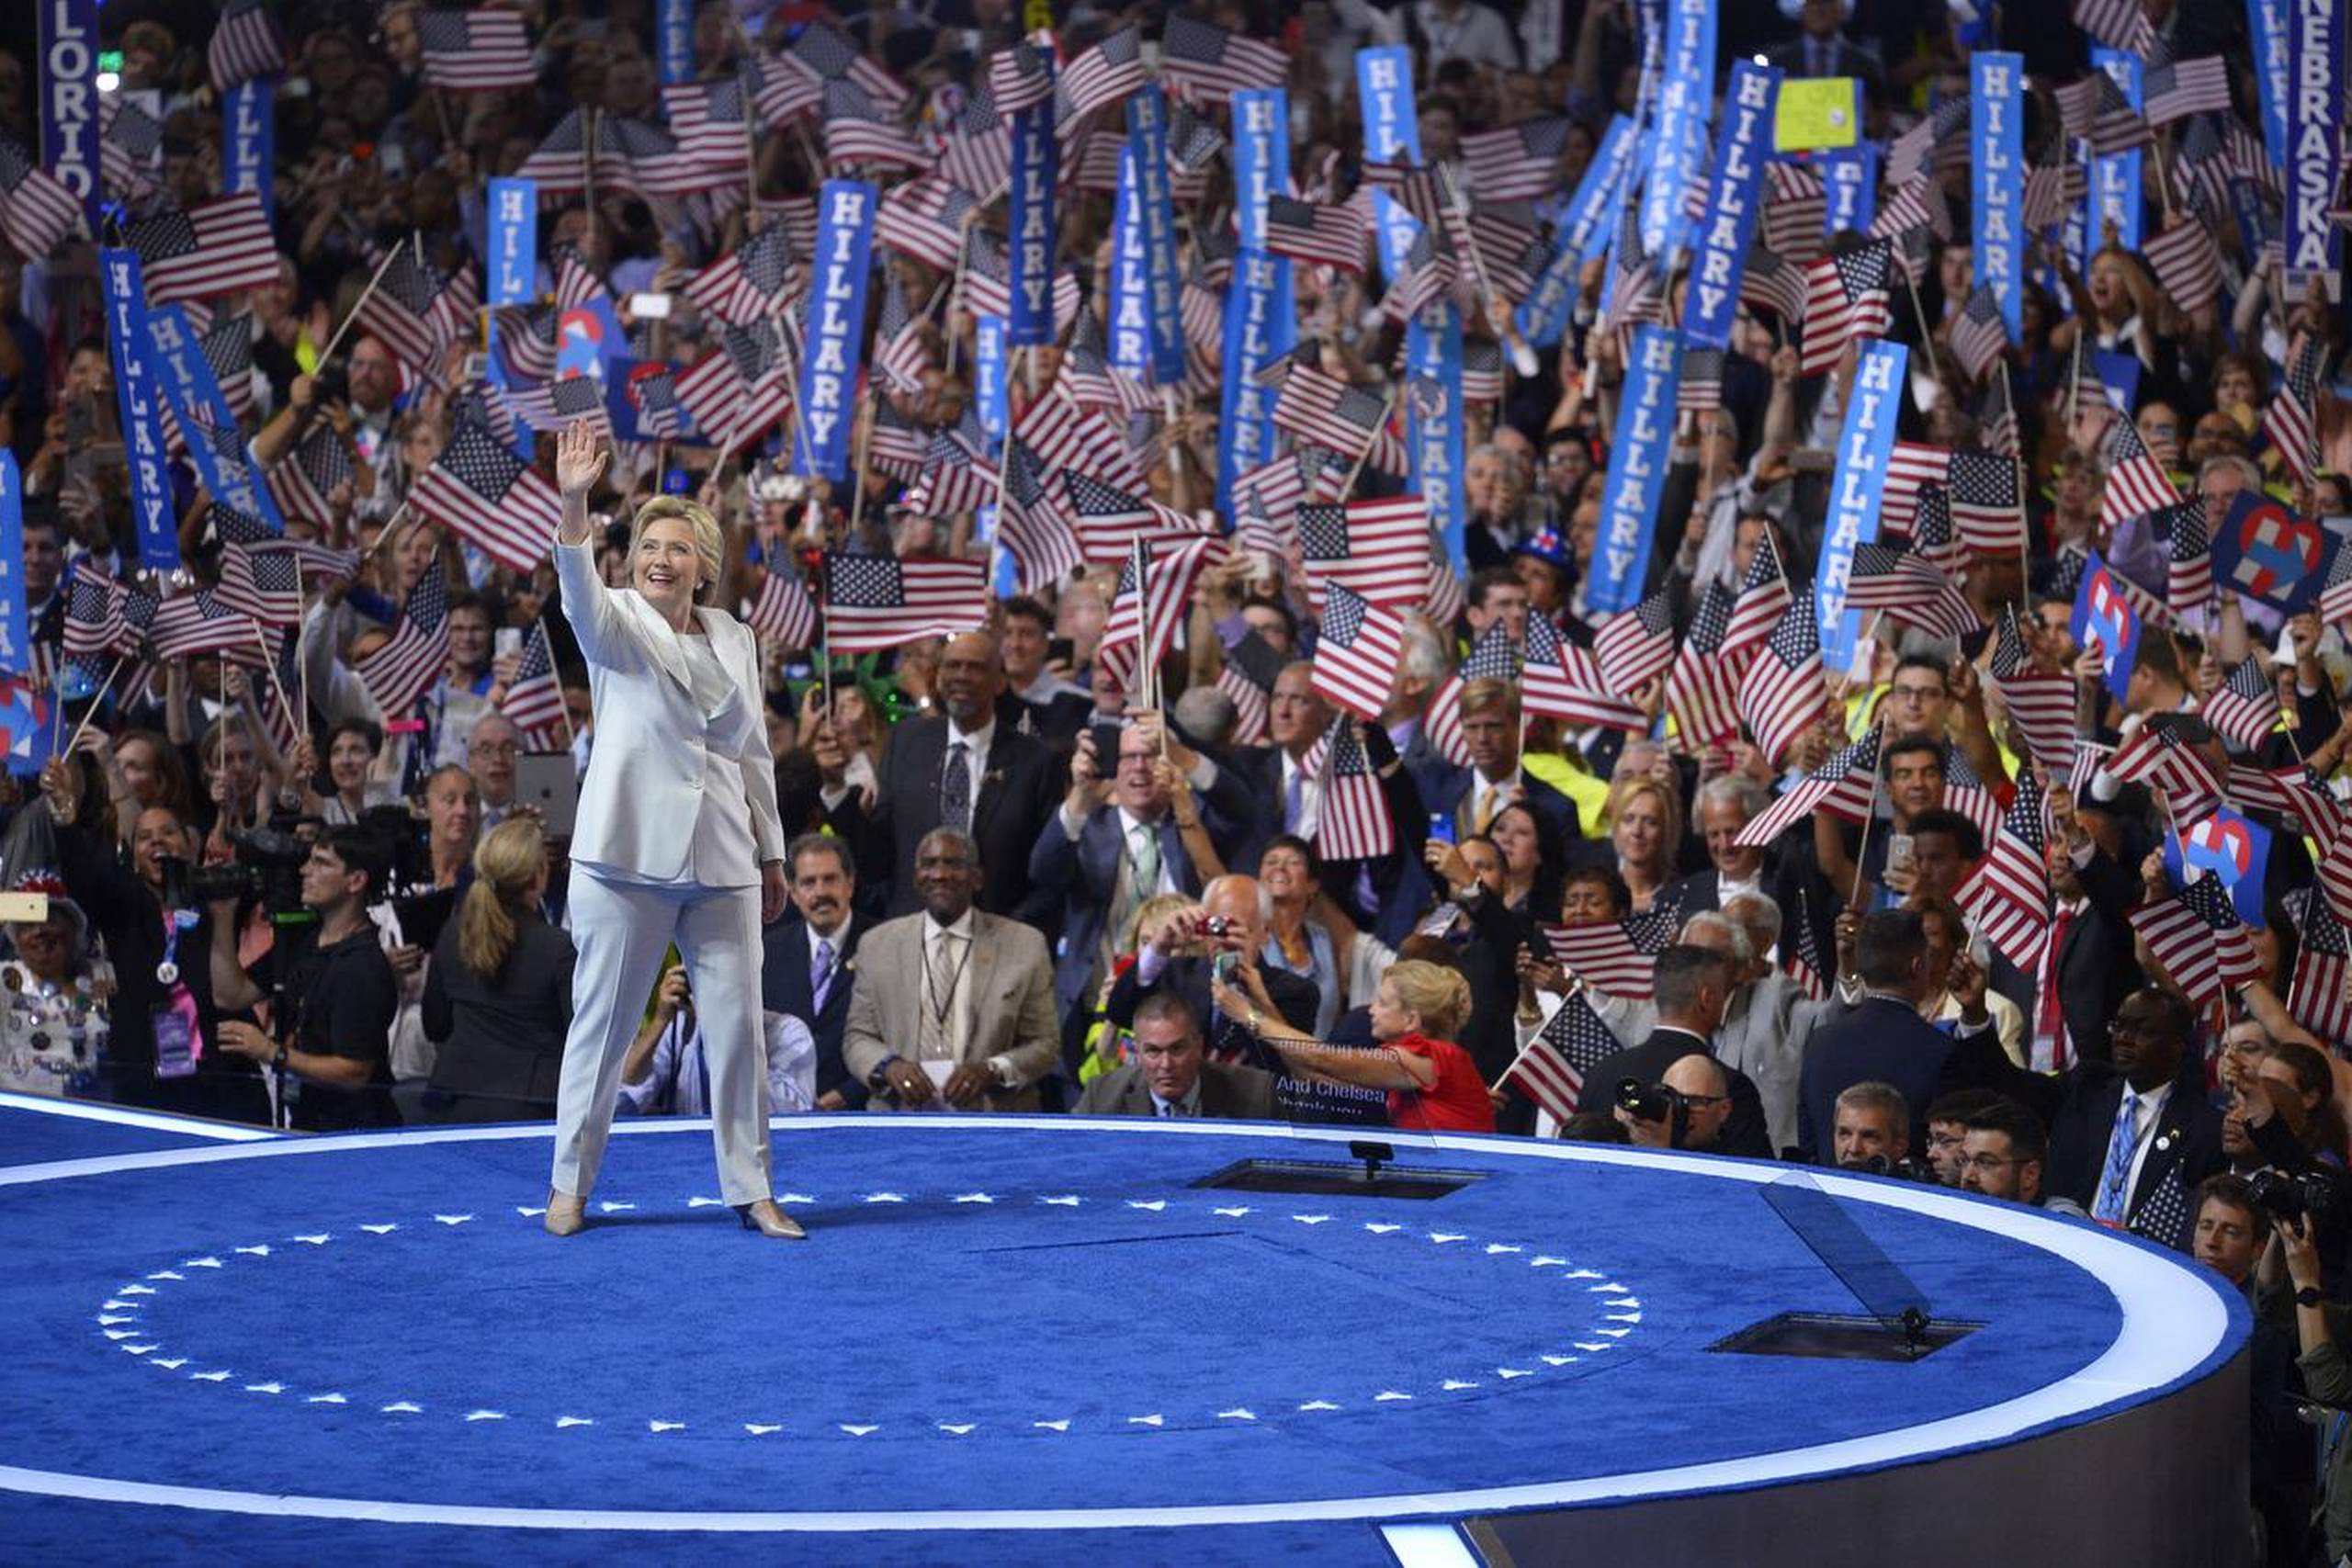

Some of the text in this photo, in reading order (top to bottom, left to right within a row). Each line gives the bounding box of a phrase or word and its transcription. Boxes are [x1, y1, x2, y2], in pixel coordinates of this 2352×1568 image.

[1021, 57, 1048, 312] ILLARY
[1701, 73, 1770, 320] HILLARY
[109, 261, 164, 534] HILLARY
[809, 191, 865, 446] HILLARY
[1606, 337, 1674, 581] HILLARY
[1821, 351, 1894, 630] HILLARY
[1276, 1075, 1311, 1095] And
[1316, 1080, 1386, 1103] Chelsea
